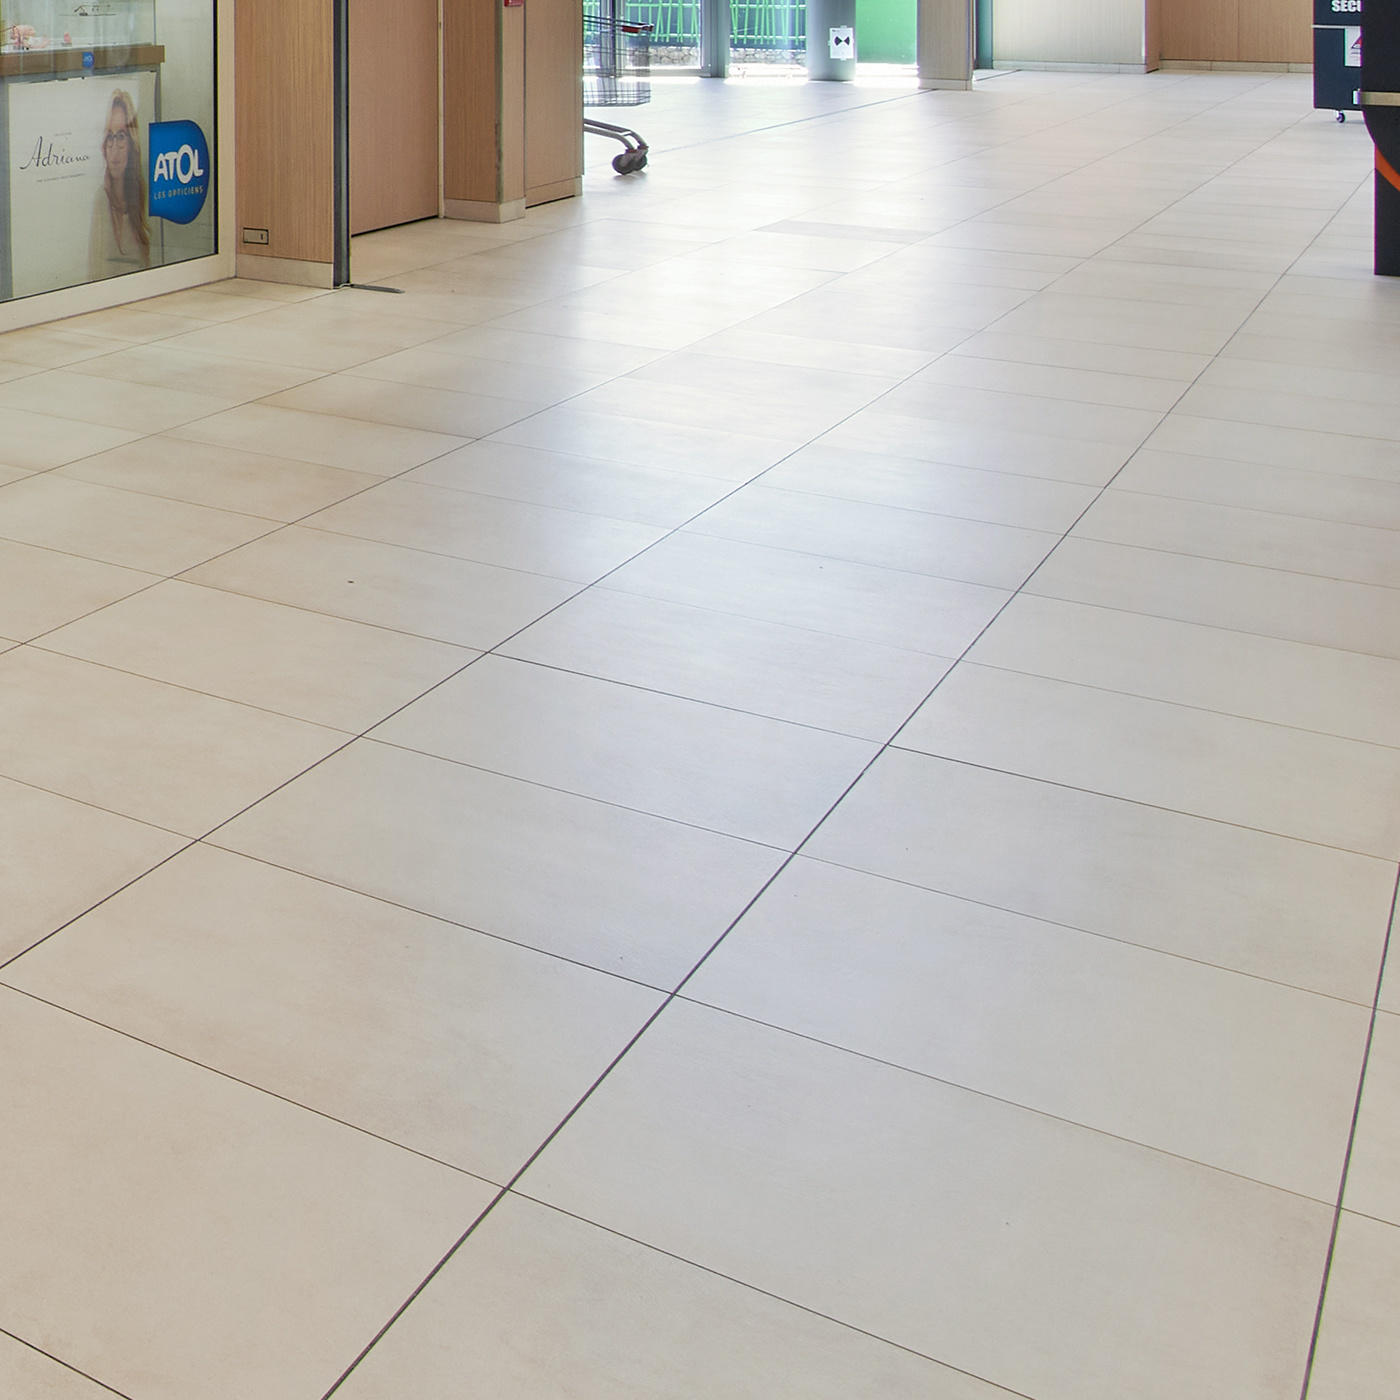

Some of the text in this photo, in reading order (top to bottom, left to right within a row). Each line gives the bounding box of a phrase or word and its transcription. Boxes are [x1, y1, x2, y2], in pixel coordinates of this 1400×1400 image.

[19, 135, 91, 170] Adriana
[153, 144, 203, 184] ATOL
[153, 186, 203, 200] LES OPTICIENS
